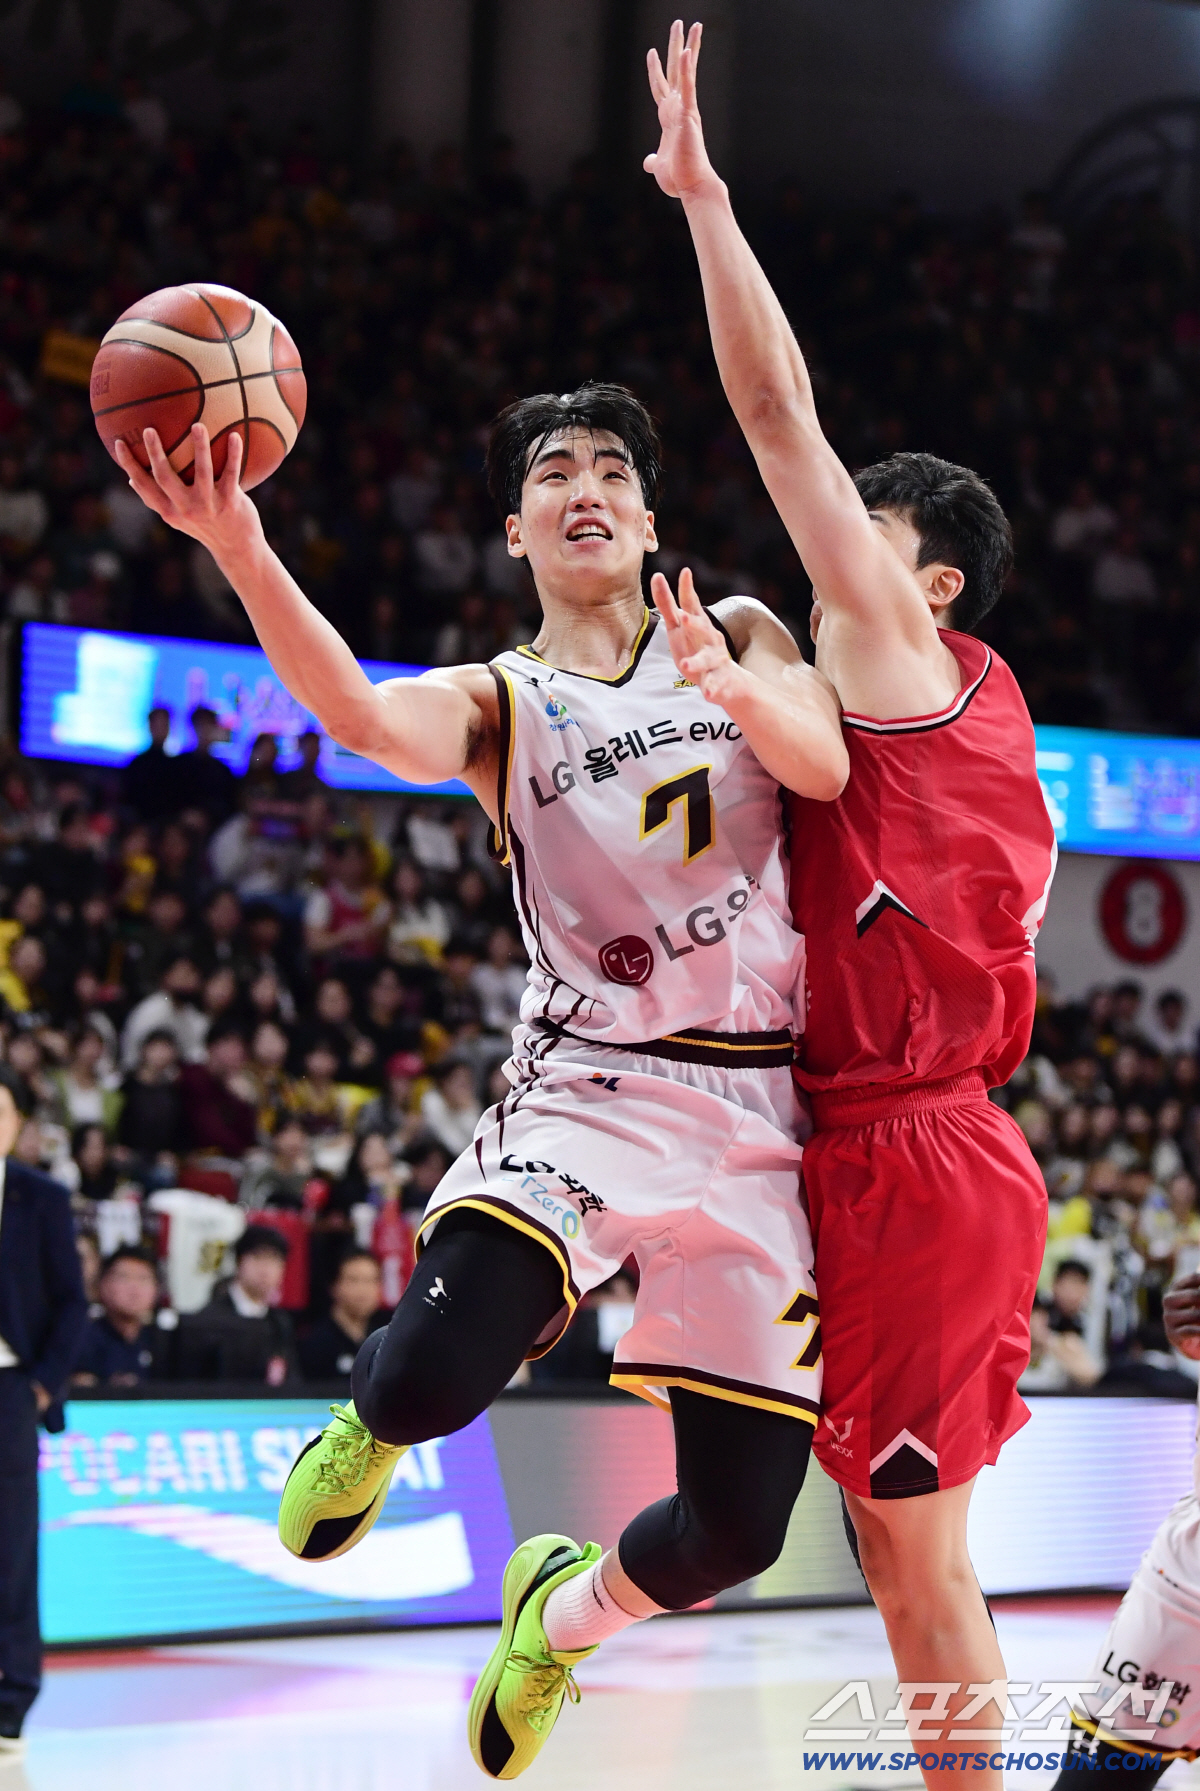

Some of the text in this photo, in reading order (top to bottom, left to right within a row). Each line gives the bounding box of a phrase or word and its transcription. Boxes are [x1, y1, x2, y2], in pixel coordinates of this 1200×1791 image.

[528, 719, 742, 809] LG 올레드 evo
[639, 763, 717, 869] 7
[773, 1288, 823, 1372] 7
